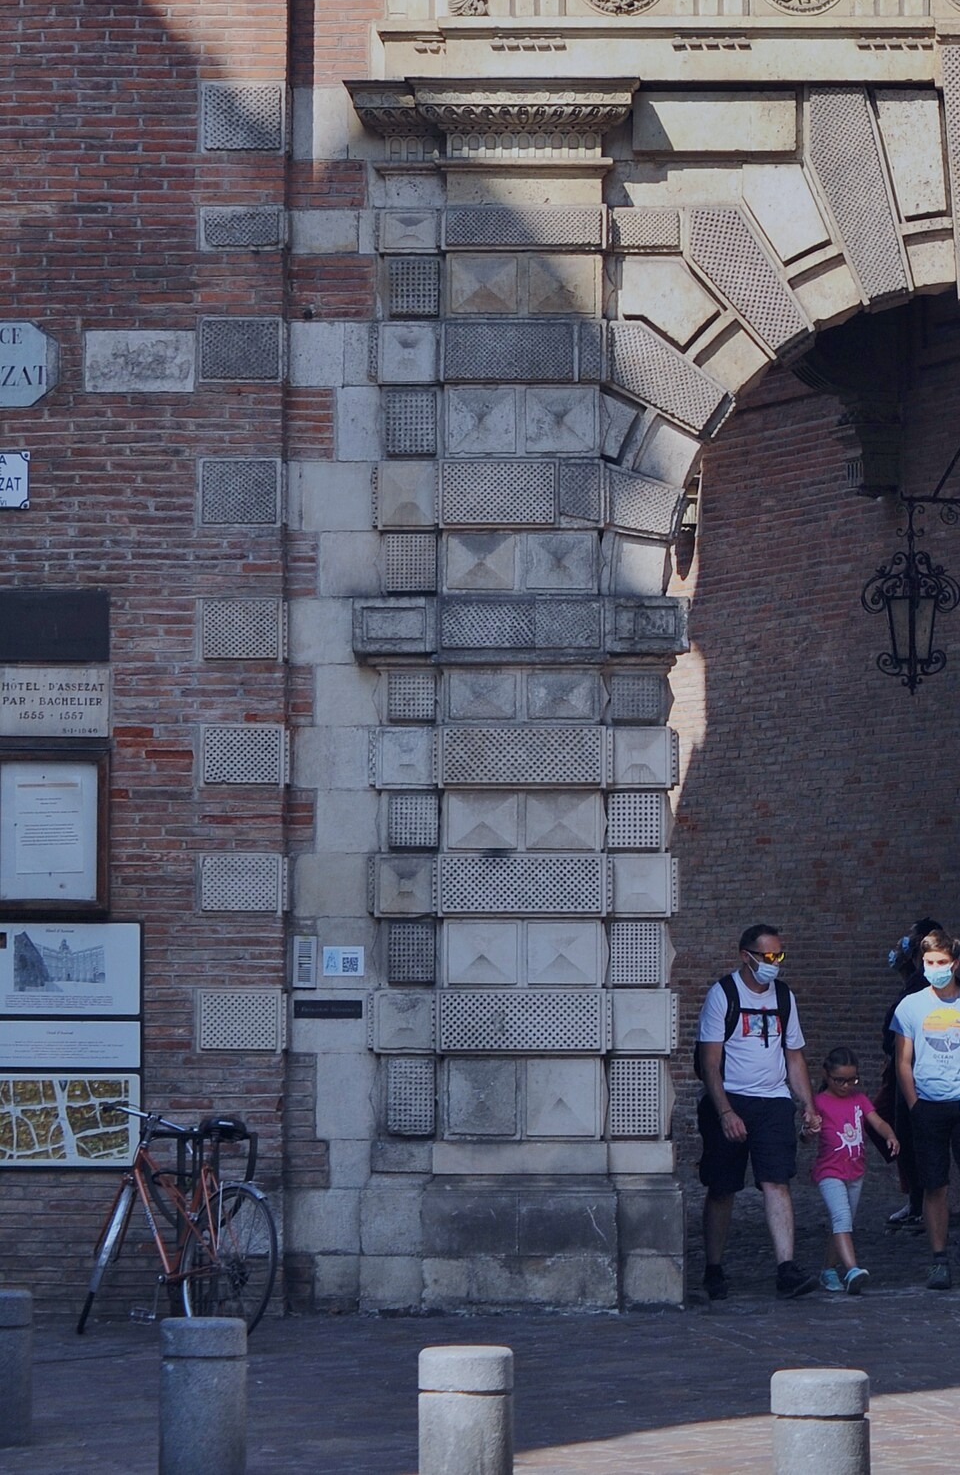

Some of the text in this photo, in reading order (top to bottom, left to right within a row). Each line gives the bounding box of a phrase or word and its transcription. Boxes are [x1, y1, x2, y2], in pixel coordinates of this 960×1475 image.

[48, 682, 105, 692] D'ASSEZAT
[2, 696, 103, 706] PAR BACHELIER
[19, 711, 84, 720] 1555 1557
